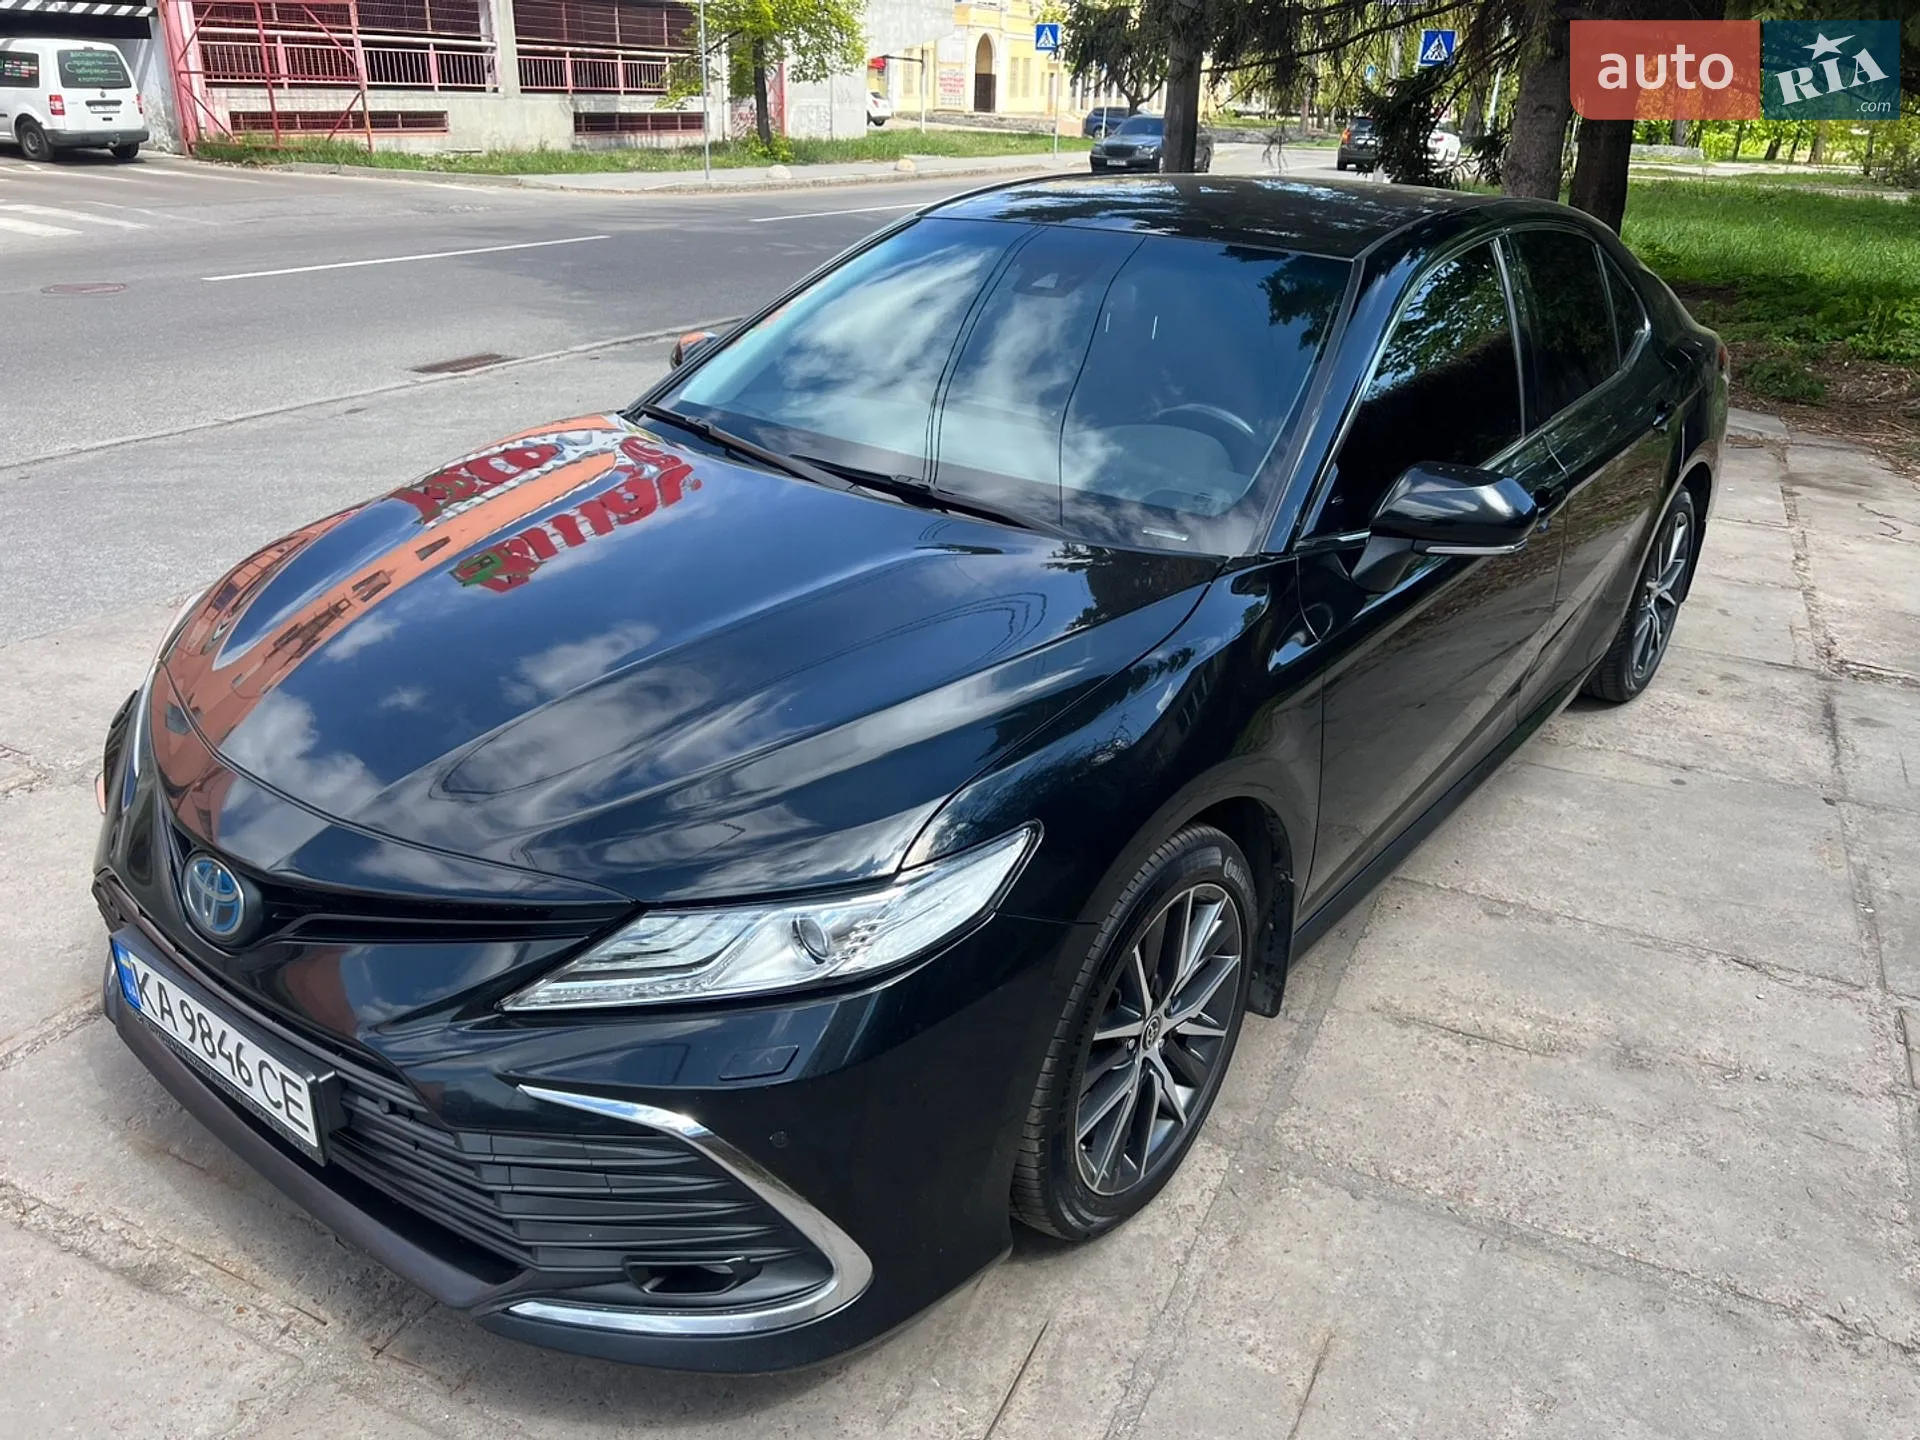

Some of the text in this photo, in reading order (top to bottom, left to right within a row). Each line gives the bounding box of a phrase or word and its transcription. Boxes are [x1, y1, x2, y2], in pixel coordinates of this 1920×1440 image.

[131, 962, 179, 1032] KA
[179, 999, 254, 1088] 9846
[258, 1059, 310, 1133] CE
